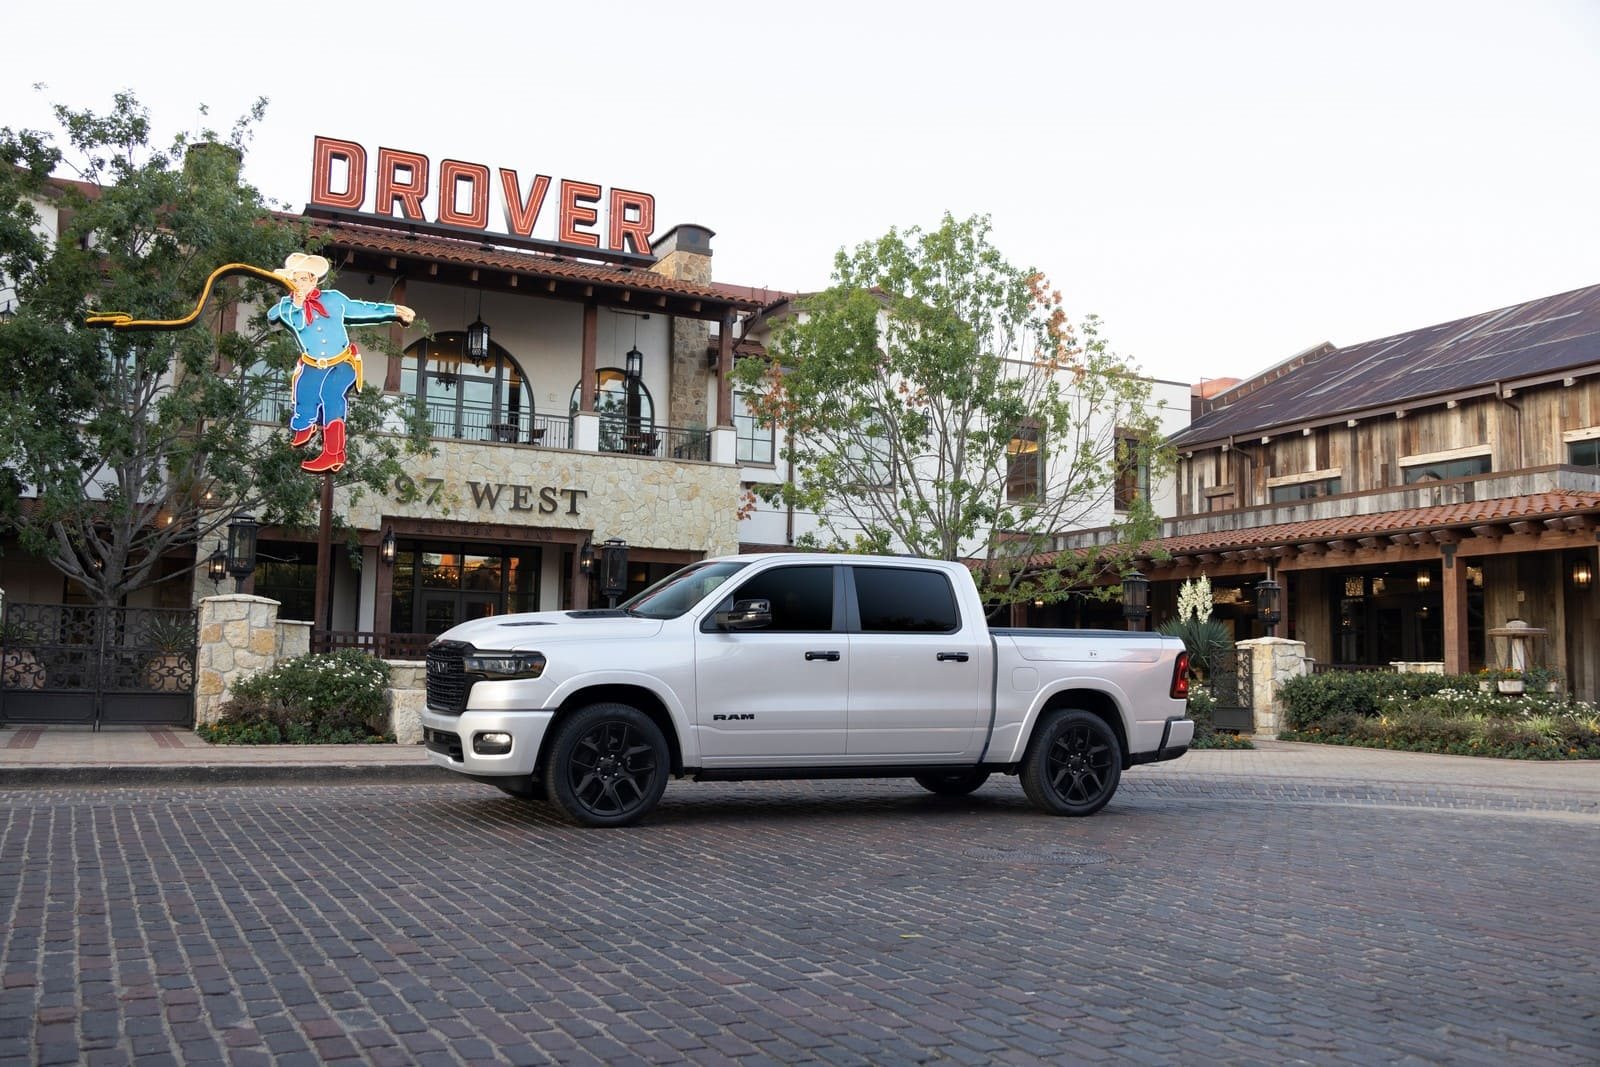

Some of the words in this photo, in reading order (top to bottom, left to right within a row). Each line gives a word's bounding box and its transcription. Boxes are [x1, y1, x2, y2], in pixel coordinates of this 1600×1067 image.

[311, 135, 656, 257] DROVER
[395, 474, 444, 505] 97
[465, 481, 588, 516] WEST
